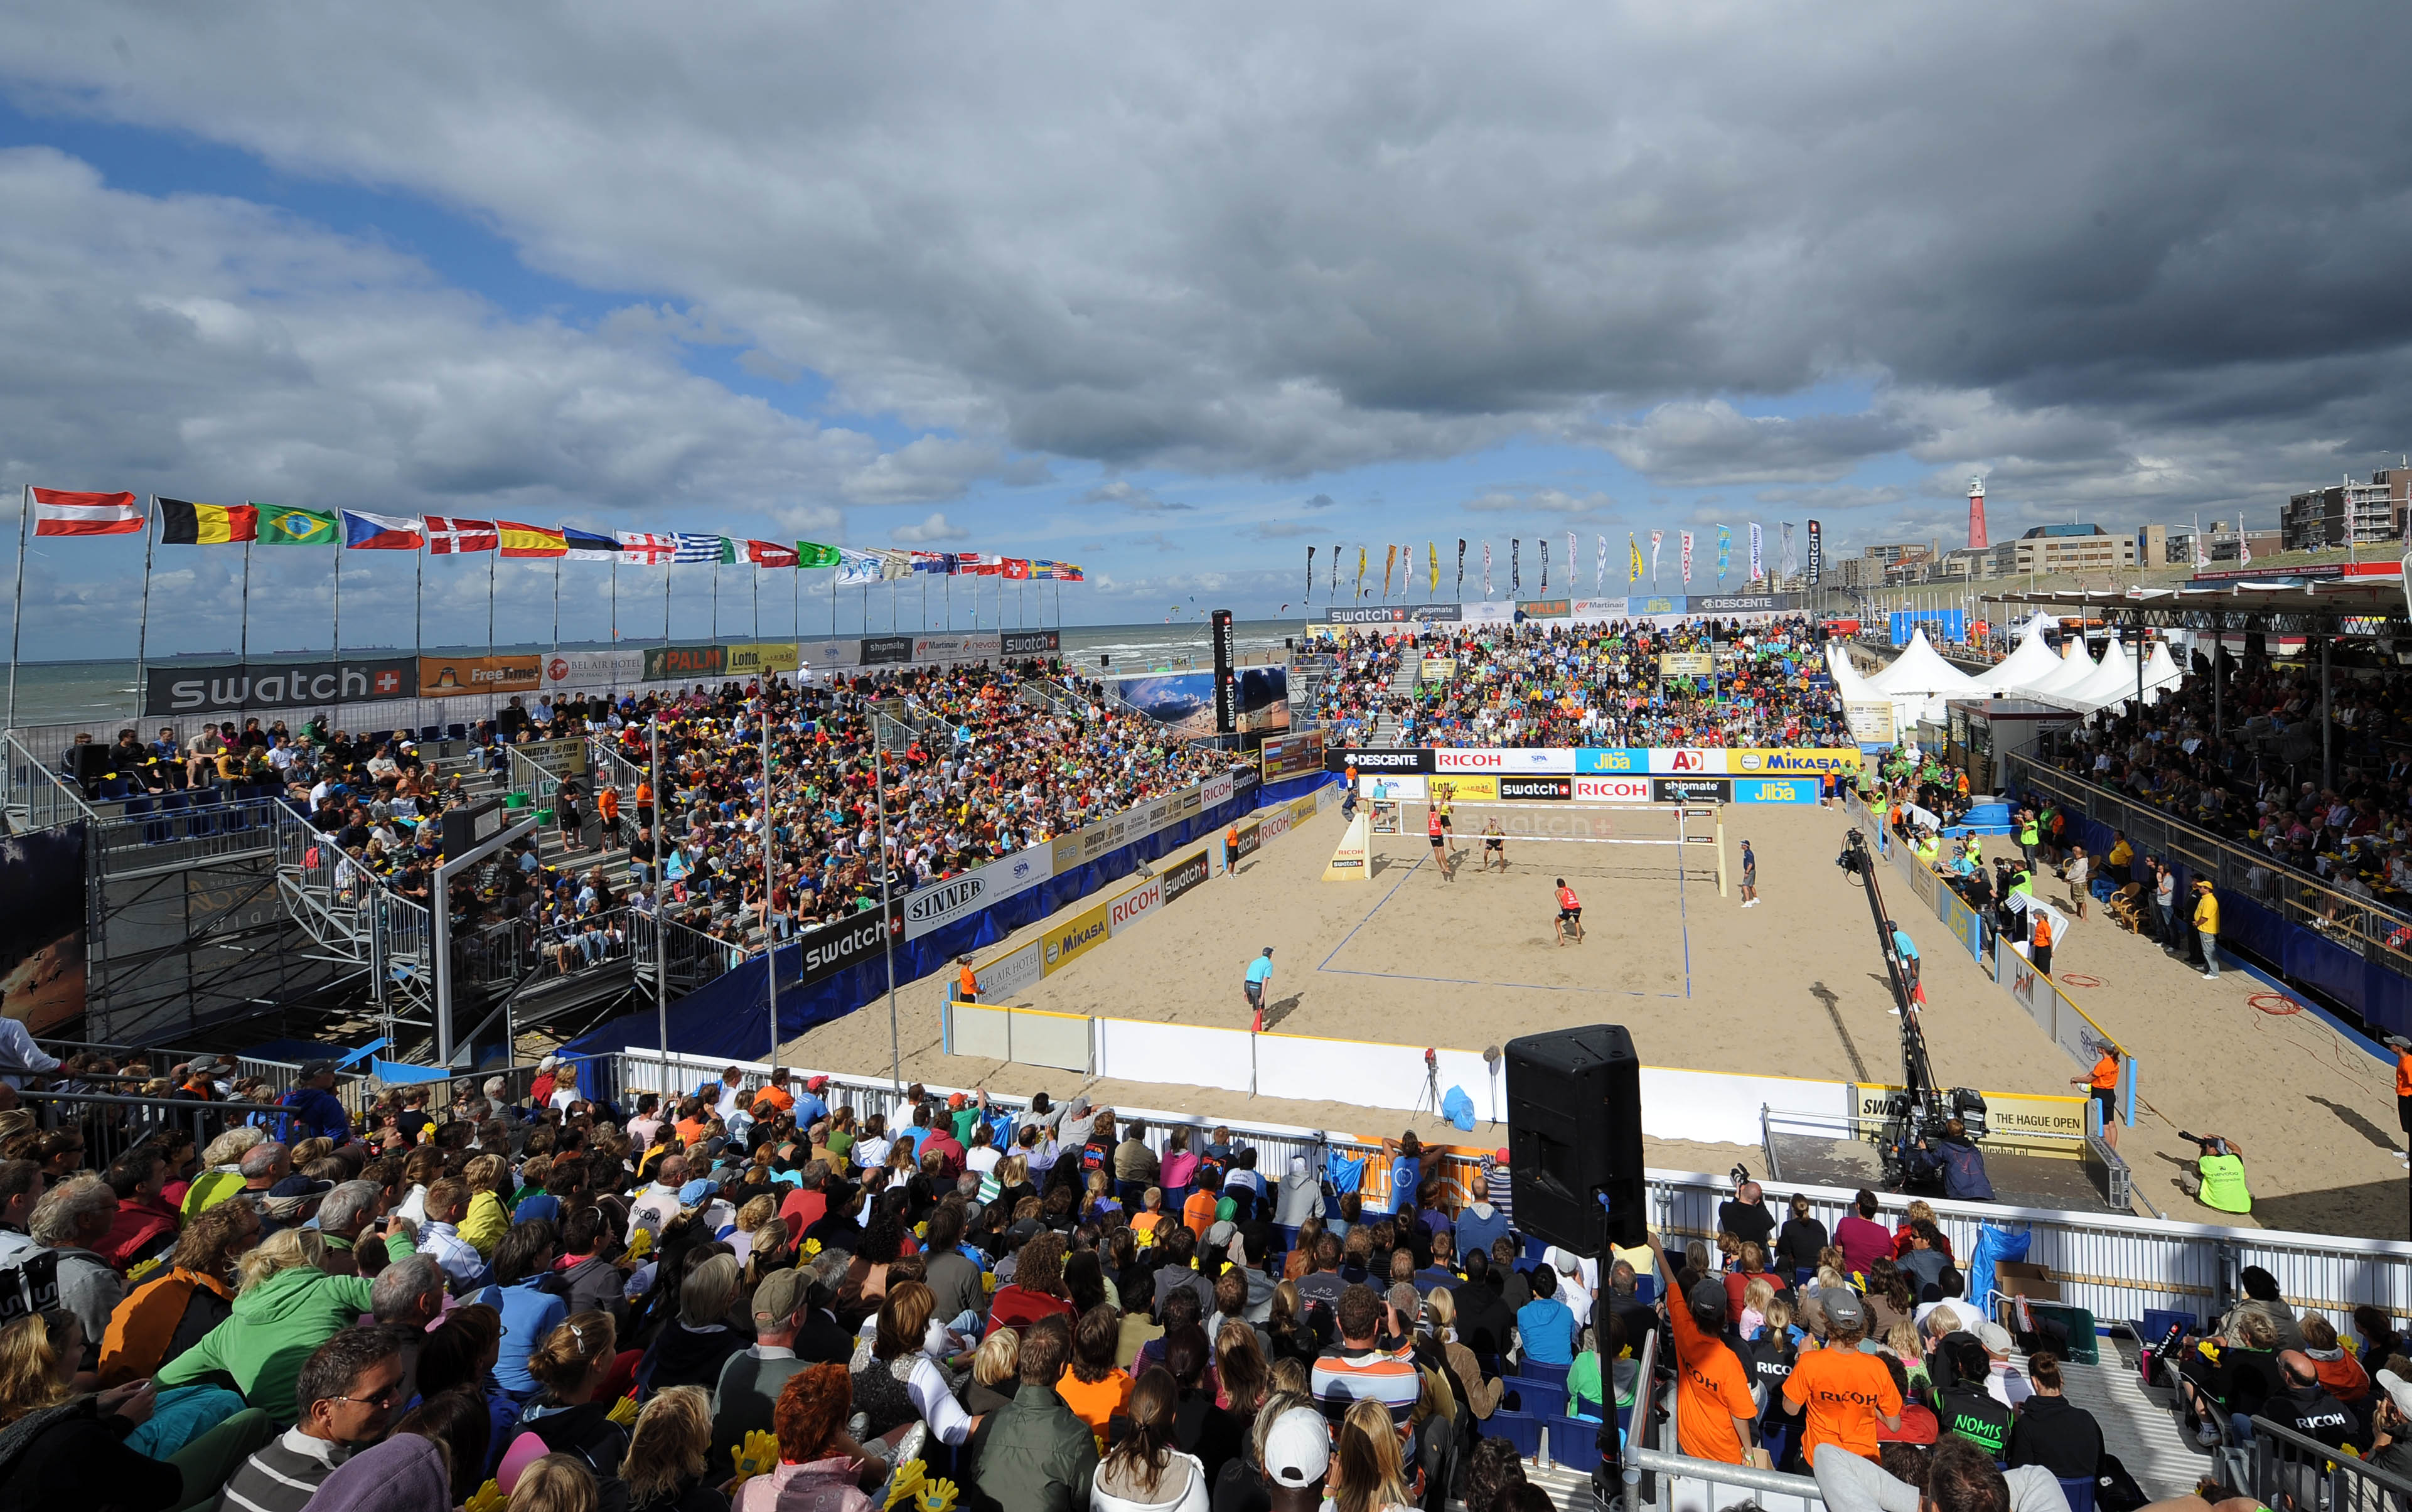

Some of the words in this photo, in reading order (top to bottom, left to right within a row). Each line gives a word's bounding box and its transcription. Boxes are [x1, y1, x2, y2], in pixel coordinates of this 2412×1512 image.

[1809, 533, 1819, 584] swatch
[1418, 607, 1453, 616] shipmate
[1530, 602, 1566, 614] PALM
[1589, 601, 1624, 609] Martinair
[1643, 598, 1672, 613] Jiba
[1715, 598, 1772, 608] DESCENTE
[1331, 609, 1388, 623] swatch
[870, 641, 904, 651] shipmate
[928, 639, 958, 649] Martinair
[972, 641, 1000, 649] nevobo
[1006, 636, 1046, 651] swatch
[572, 661, 588, 669] BEL
[592, 660, 608, 669] AIR
[611, 660, 641, 668] HOTEL
[667, 650, 720, 670] PALM
[732, 652, 761, 666] Lotto.
[471, 665, 539, 682] FreeTime!
[171, 668, 367, 708] swatch
[1226, 684, 1235, 727] swatch
[521, 746, 550, 757] SWATCH
[562, 743, 578, 753] FIVB
[1358, 754, 1418, 766] DESCENTE
[1439, 754, 1501, 766] RICOH
[1594, 752, 1631, 770] Jiba
[1672, 751, 1703, 771] AD
[1766, 753, 1841, 769] MIKASA
[1234, 773, 1255, 790] swatch
[1503, 783, 1558, 795] swatch
[1579, 783, 1646, 796] RICOH
[1664, 780, 1718, 790] shipmate
[1203, 781, 1231, 803] RICOH
[1755, 782, 1795, 801] Jiba
[1184, 796, 1199, 806] swatch
[1150, 805, 1166, 822] SWATCH
[1173, 800, 1182, 812] FIVB
[1298, 805, 1314, 819] MIKASA
[1150, 819, 1164, 829] WORLD
[1164, 815, 1173, 825] TOUR
[1262, 815, 1289, 841] RICOH
[1085, 830, 1105, 849] SWATCH
[1114, 822, 1124, 837] FIVB
[1238, 834, 1255, 854] atch
[1057, 845, 1077, 862] FIVB
[1085, 845, 1101, 857] WORLD
[1102, 841, 1114, 851] TOUR
[1115, 835, 1124, 845] 2009
[1014, 863, 1029, 874] SPA
[1166, 861, 1201, 896] swatch
[913, 879, 982, 920] SINNER
[1113, 885, 1159, 926] RICOH
[932, 908, 965, 925] EYEWEAR
[1948, 897, 1968, 936] Jiba
[806, 920, 886, 972] swatch
[1063, 921, 1105, 955] MIKASA
[996, 966, 1012, 982] AIR
[1014, 951, 1038, 974] HOTEL
[982, 991, 994, 1003] DEN
[995, 985, 1008, 997] HAAG
[1012, 977, 1021, 987] THE
[1022, 967, 1038, 982] HAGUE
[1863, 1098, 1895, 1116] SWA
[1995, 1113, 2014, 1124] THE
[2017, 1115, 2050, 1127] HAGUE
[2053, 1117, 2080, 1129] OPEN
[632, 1205, 660, 1224] RICOH
[1757, 1361, 1793, 1376] RICO
[1820, 1390, 1877, 1405] RICOH
[1954, 1413, 2003, 1440] NOMIS
[2295, 1411, 2346, 1430] RICOH
